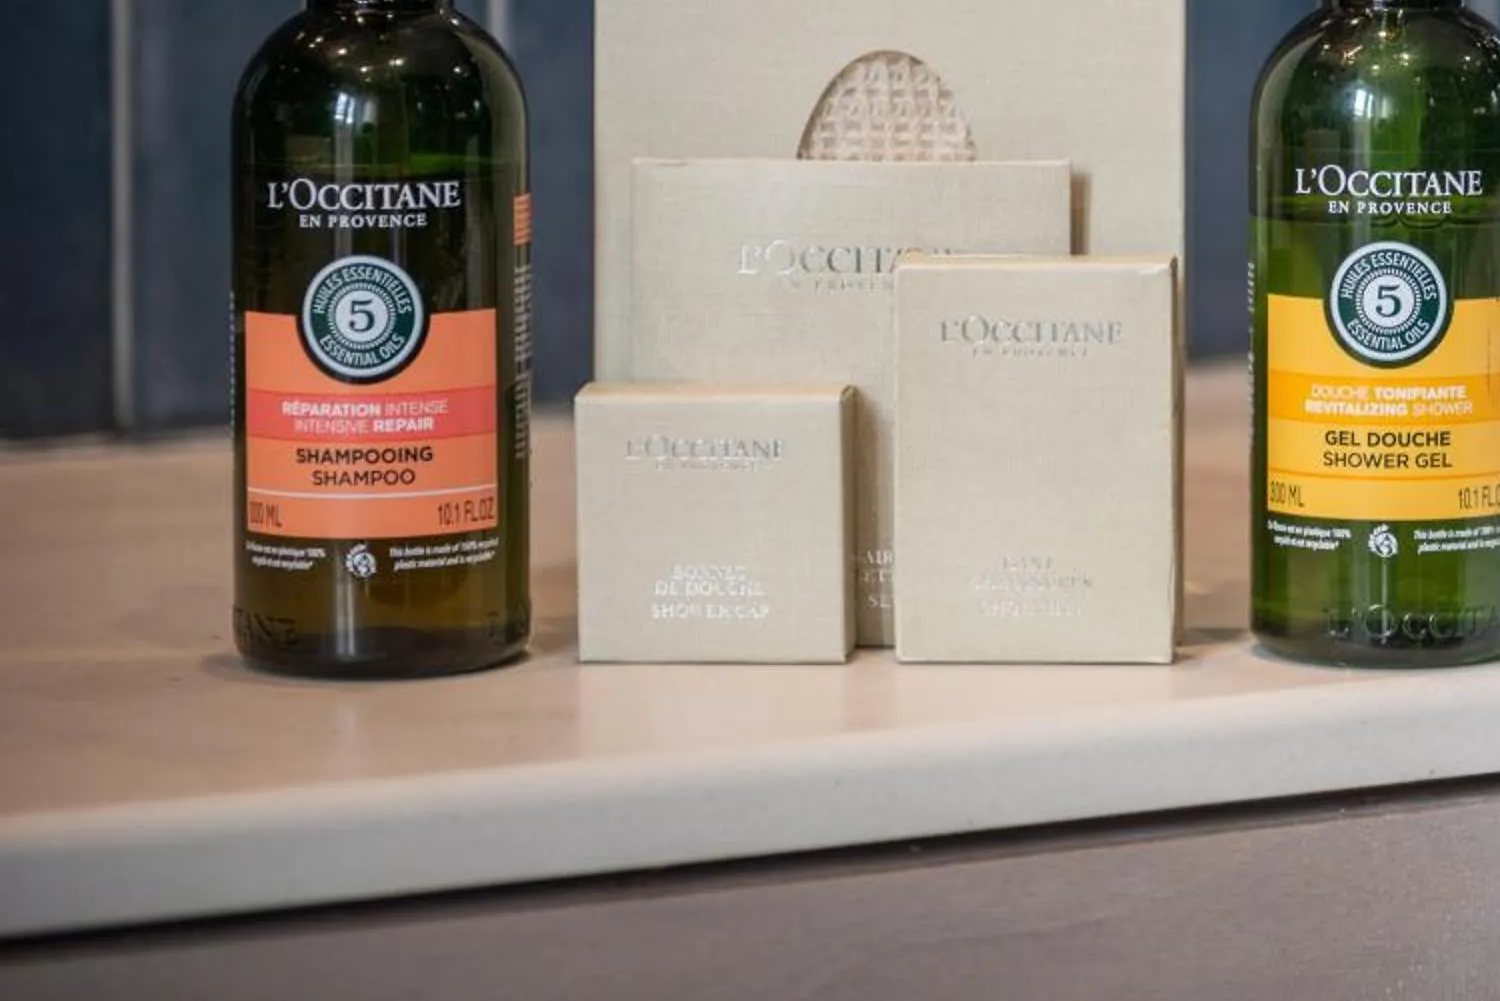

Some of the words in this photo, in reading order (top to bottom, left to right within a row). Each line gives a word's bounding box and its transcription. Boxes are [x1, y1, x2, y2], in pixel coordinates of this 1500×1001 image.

[1295, 164, 1483, 197] L'OCCITANE
[267, 178, 462, 211] L'OCCITANE
[1328, 200, 1349, 214] EN
[1357, 200, 1453, 215] PROVENCE
[299, 214, 321, 229] EN
[328, 212, 428, 229] PROVENCE
[1341, 258, 1371, 299] HUILES
[1370, 252, 1437, 300] ESSENTIELLES
[1375, 284, 1402, 318] 5
[349, 299, 375, 332] 5
[939, 313, 1124, 345] L'OCCITANE
[1346, 318, 1407, 350] ESSENTIAL
[1404, 318, 1430, 345] OILS
[319, 334, 381, 366] ESSENTIAL
[281, 399, 382, 417] RÉPARATION
[384, 399, 449, 416] INTENSE
[373, 416, 434, 433] REPAIR
[1324, 430, 1361, 447] GEL
[1367, 430, 1452, 448] DOUCHE
[296, 446, 434, 465] SHAMPOOING
[1322, 450, 1409, 469] SHOWER
[1415, 451, 1454, 469] GEL
[311, 468, 417, 486] SHAMPOO
[1288, 483, 1305, 508] ML
[265, 502, 284, 527] ML
